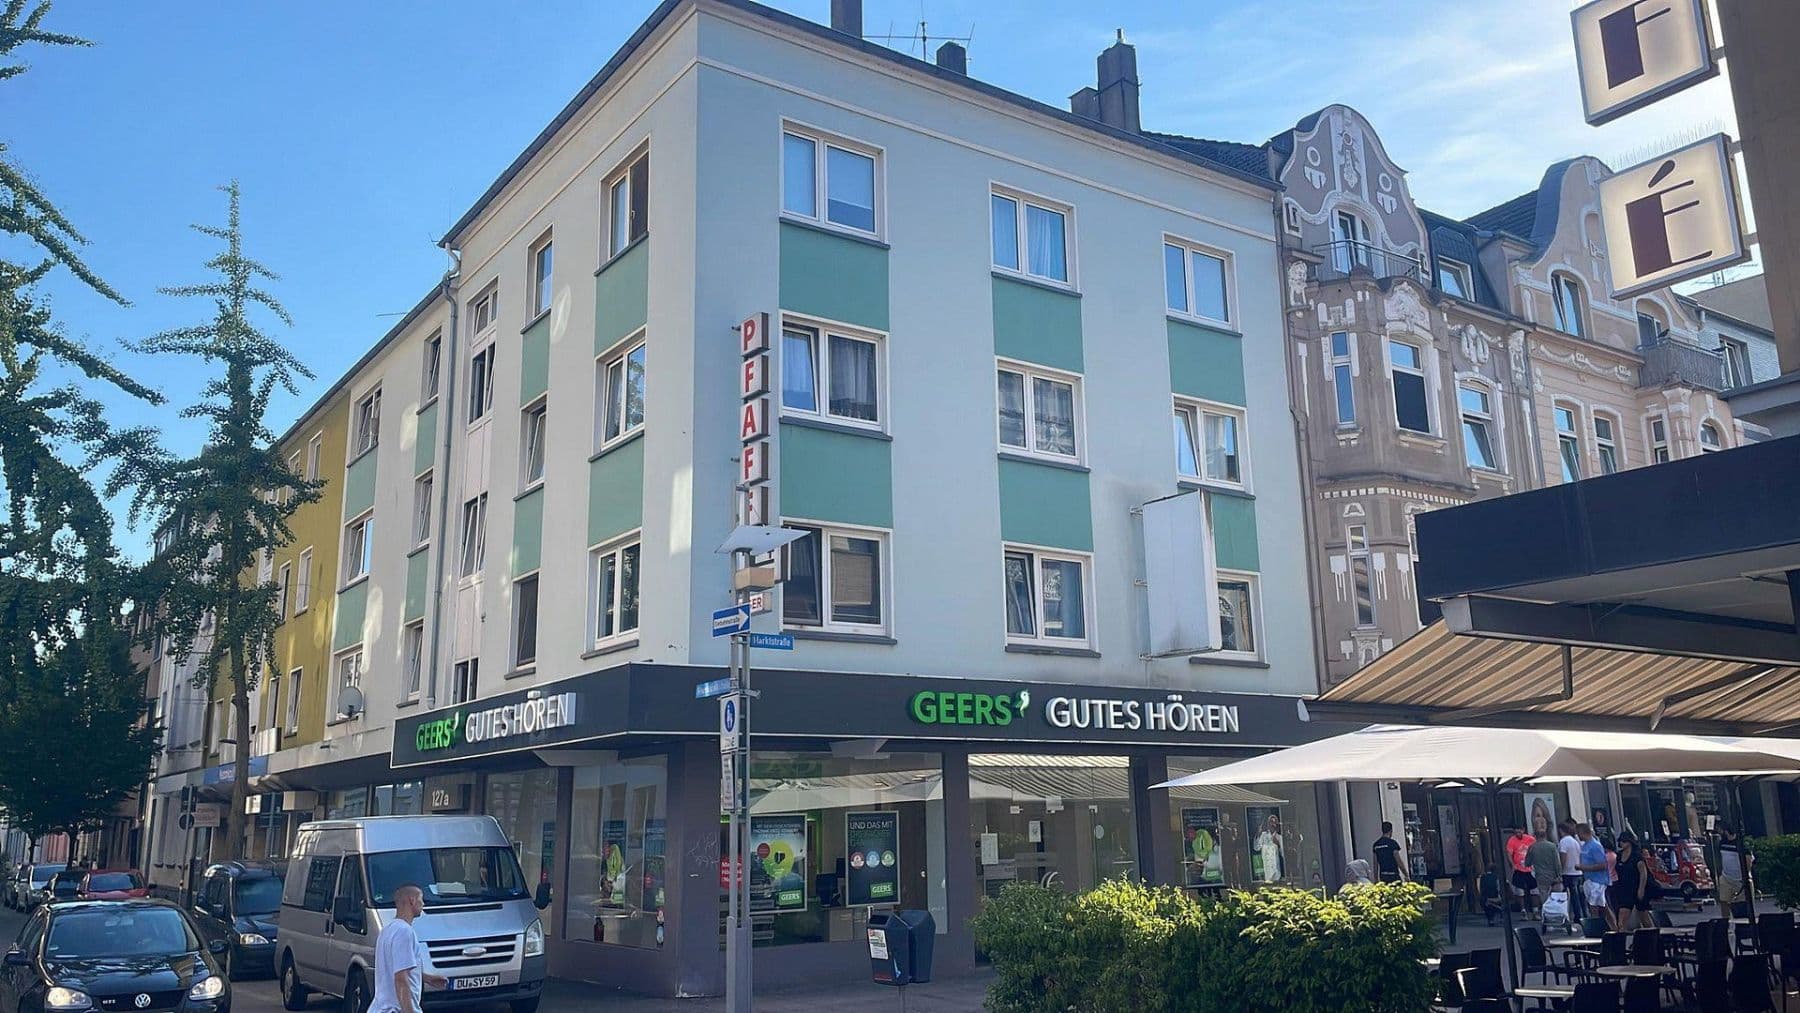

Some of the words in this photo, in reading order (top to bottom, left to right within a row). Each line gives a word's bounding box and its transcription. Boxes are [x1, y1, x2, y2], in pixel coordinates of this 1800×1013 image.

[912, 690, 1011, 726] GEERS
[1046, 697, 1141, 730] GUTES
[1145, 694, 1240, 733] HÖREN
[416, 718, 450, 751] GEERS
[465, 705, 512, 744] GUTES
[512, 690, 576, 735] HÖREN
[431, 788, 449, 807] 127a
[849, 821, 866, 830] UND
[866, 821, 881, 829] DAS
[881, 820, 893, 829] MIT
[872, 884, 892, 893] GEERS
[781, 893, 800, 901] GEERS
